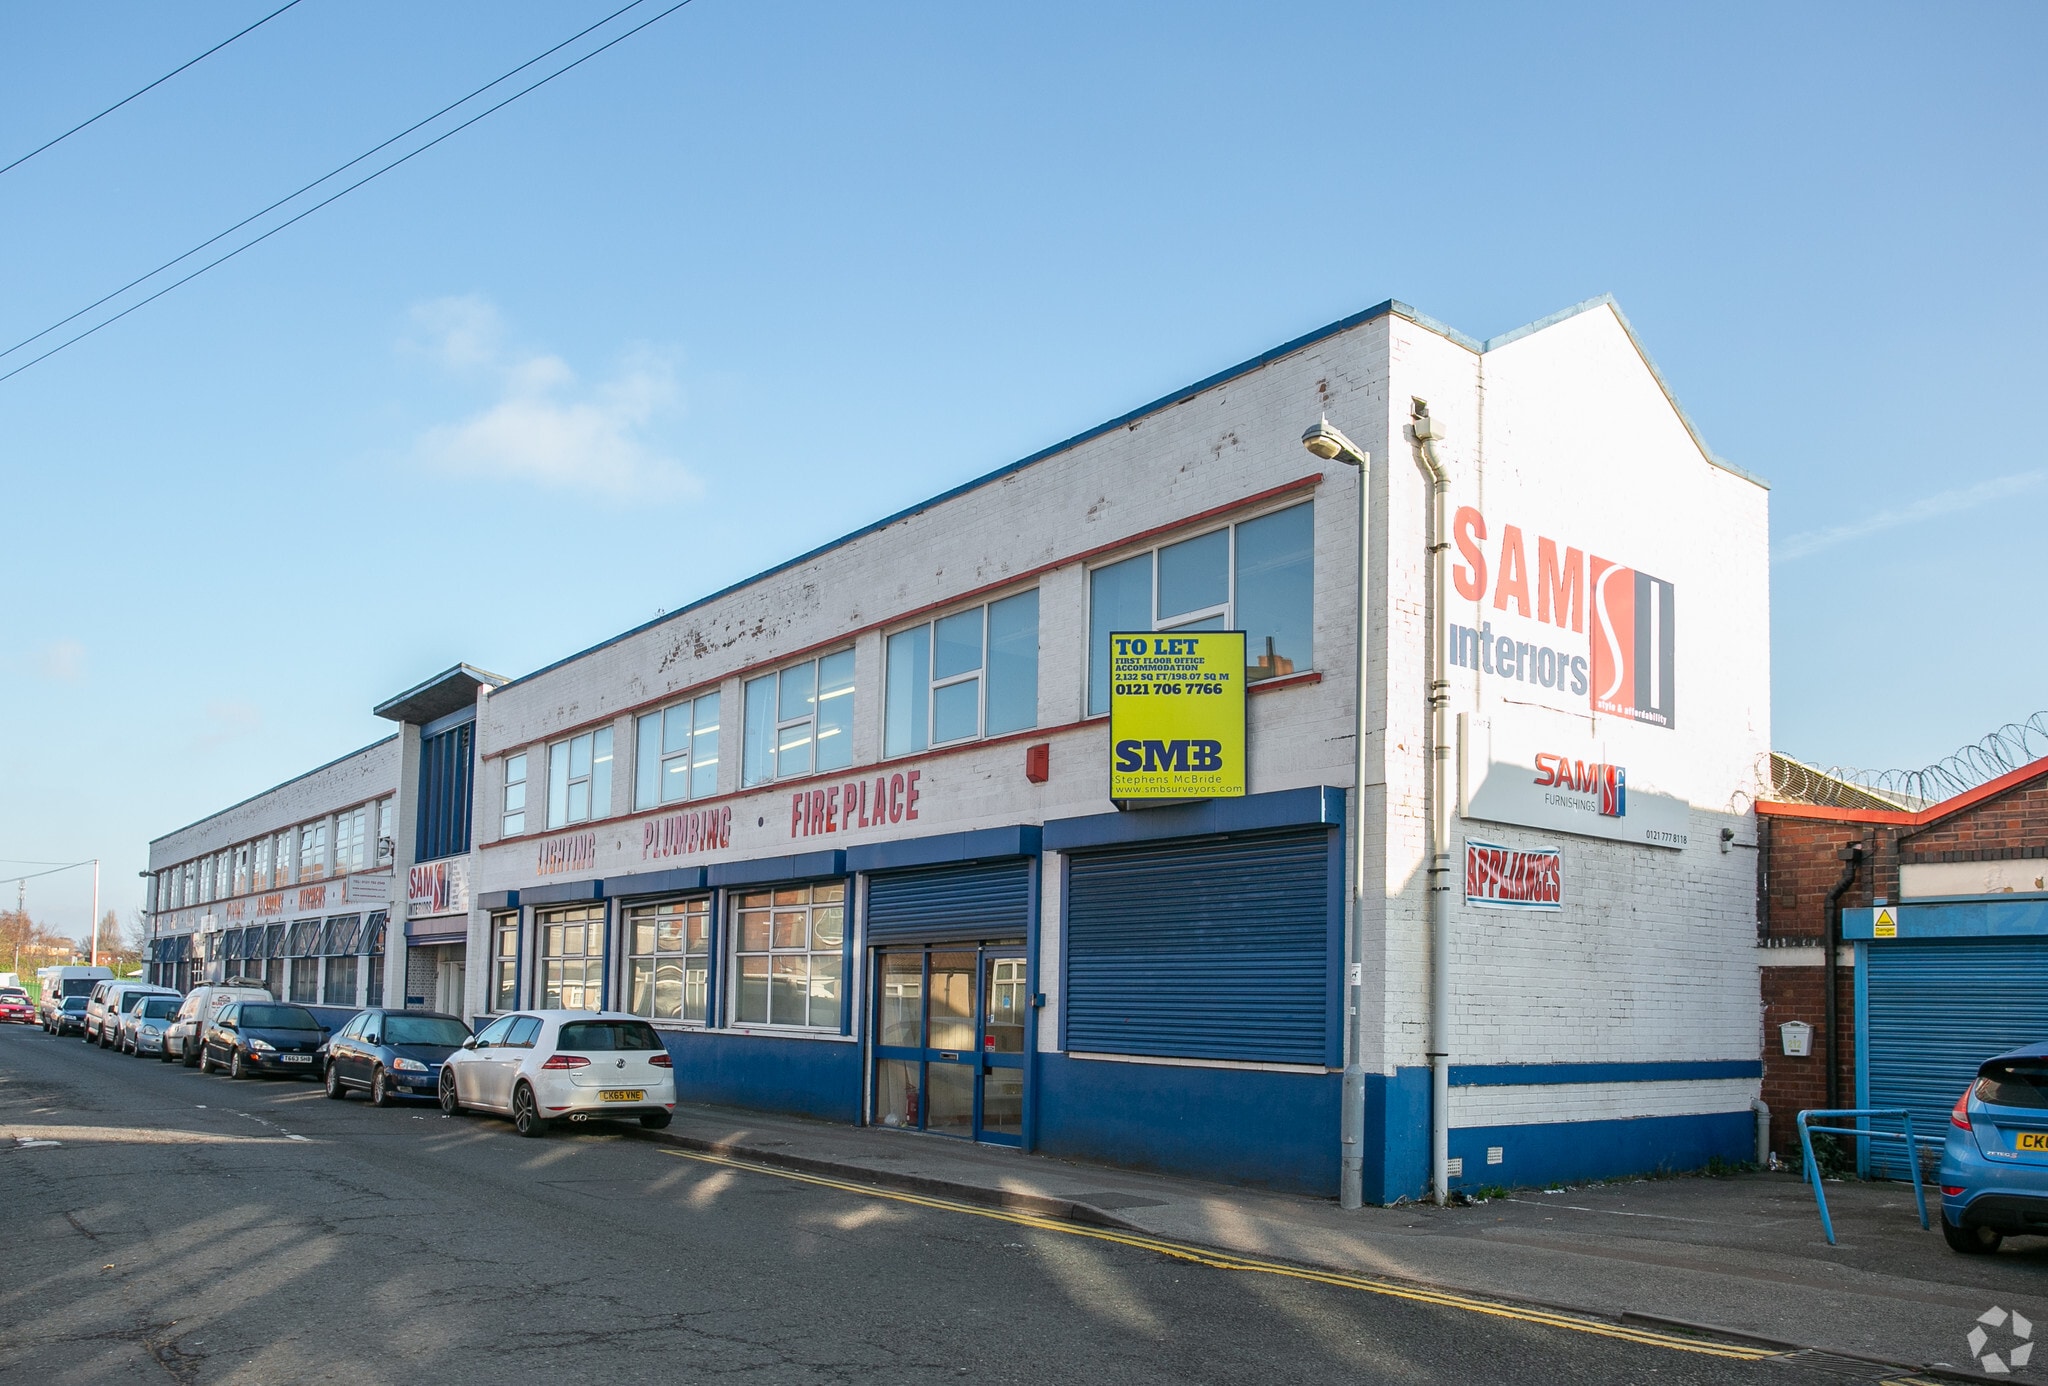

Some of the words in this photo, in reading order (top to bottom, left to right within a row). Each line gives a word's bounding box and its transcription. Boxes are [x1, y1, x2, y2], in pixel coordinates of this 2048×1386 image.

[1453, 505, 1584, 634] SAM
[1115, 638, 1148, 655] TO
[1154, 638, 1199, 655] LET
[1115, 657, 1141, 665] FIRST
[1143, 657, 1172, 665] FLOOR
[1174, 657, 1205, 665] OFFICE
[1115, 664, 1199, 672] ACCOMMODATION
[1115, 673, 1138, 682] 2,132
[1140, 673, 1154, 681] SQ
[1156, 673, 1202, 682] FT/198.07
[1203, 673, 1217, 681] SQ
[1219, 673, 1229, 681] M
[1115, 683, 1150, 695] 0121
[1153, 683, 1182, 695] 706
[1185, 683, 1223, 695] 7766
[1597, 700, 1616, 712] style
[1617, 703, 1623, 714] &
[1624, 706, 1668, 726] affordability
[1115, 739, 1223, 772] SMB
[1115, 774, 1169, 785] Stephens
[1174, 774, 1222, 784] McBride
[1533, 751, 1598, 796] SAM
[1115, 785, 1242, 795] www.smbsurveyors.com
[1544, 793, 1597, 813] FURNISHINGS
[536, 832, 596, 876] LIGHTING
[642, 805, 732, 860] PLUMBING
[1645, 829, 1660, 841] 0121
[1661, 831, 1672, 842] 777
[1673, 833, 1688, 845] 8118
[409, 866, 433, 900] SAM
[1467, 847, 1561, 903] APPLIANCES
[603, 1091, 625, 1100] CK65
[625, 1091, 641, 1100] VNE
